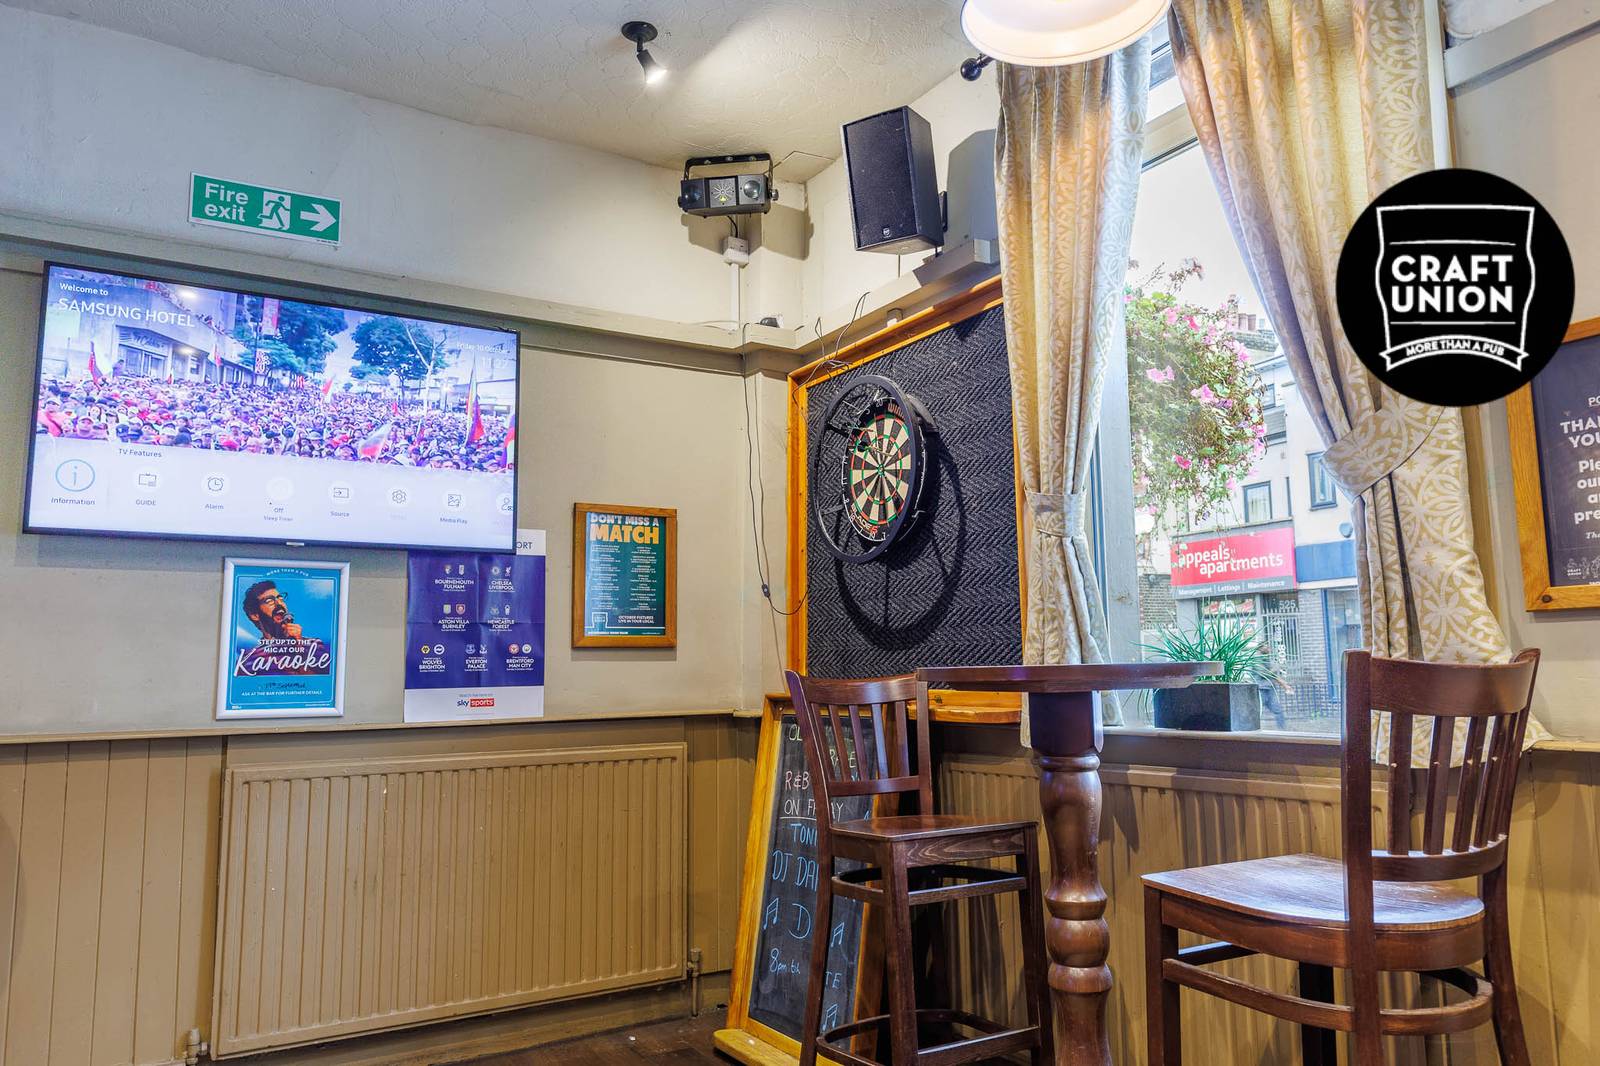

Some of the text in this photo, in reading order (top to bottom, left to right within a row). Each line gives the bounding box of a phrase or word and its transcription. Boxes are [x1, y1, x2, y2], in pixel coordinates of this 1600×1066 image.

[205, 182, 249, 205] Fire
[204, 203, 246, 222] exit
[60, 282, 109, 296] Welcome to
[58, 297, 195, 328] SAMSUNG HOTEL
[129, 449, 162, 458] Features
[51, 497, 96, 505] Information
[204, 502, 225, 510] Alarm
[591, 513, 660, 527] DON'T MISS A
[590, 523, 660, 545] MATCH
[1178, 543, 1231, 568] appeals
[1199, 552, 1284, 578] apartments
[1179, 587, 1211, 596] Management
[1217, 585, 1241, 593] Lettings
[1279, 600, 1297, 610] 525
[233, 642, 332, 677] Karaoke
[457, 699, 494, 707] sky sports
[783, 799, 800, 816] ON
[772, 849, 820, 892] DJ DA
